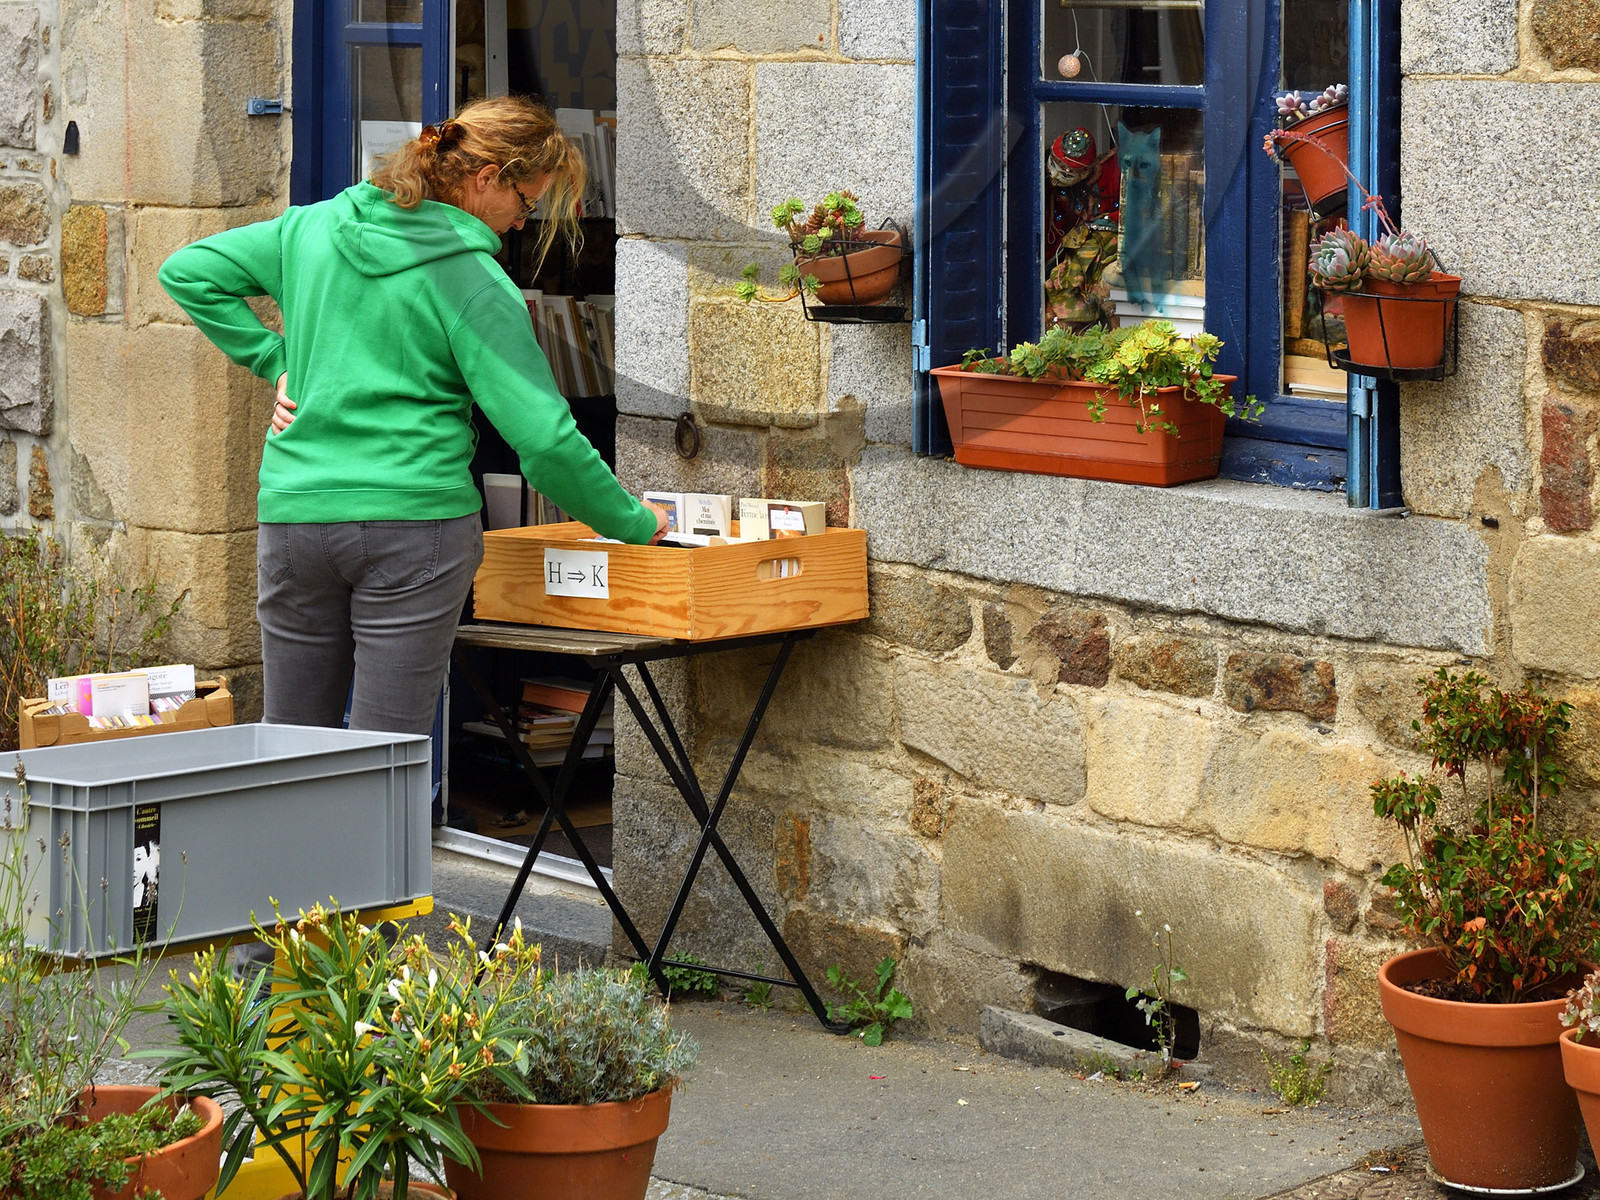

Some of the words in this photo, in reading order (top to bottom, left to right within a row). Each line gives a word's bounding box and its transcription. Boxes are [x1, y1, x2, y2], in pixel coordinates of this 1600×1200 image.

[548, 561, 562, 584] H
[592, 565, 605, 587] K
[136, 807, 157, 815] L'autre
